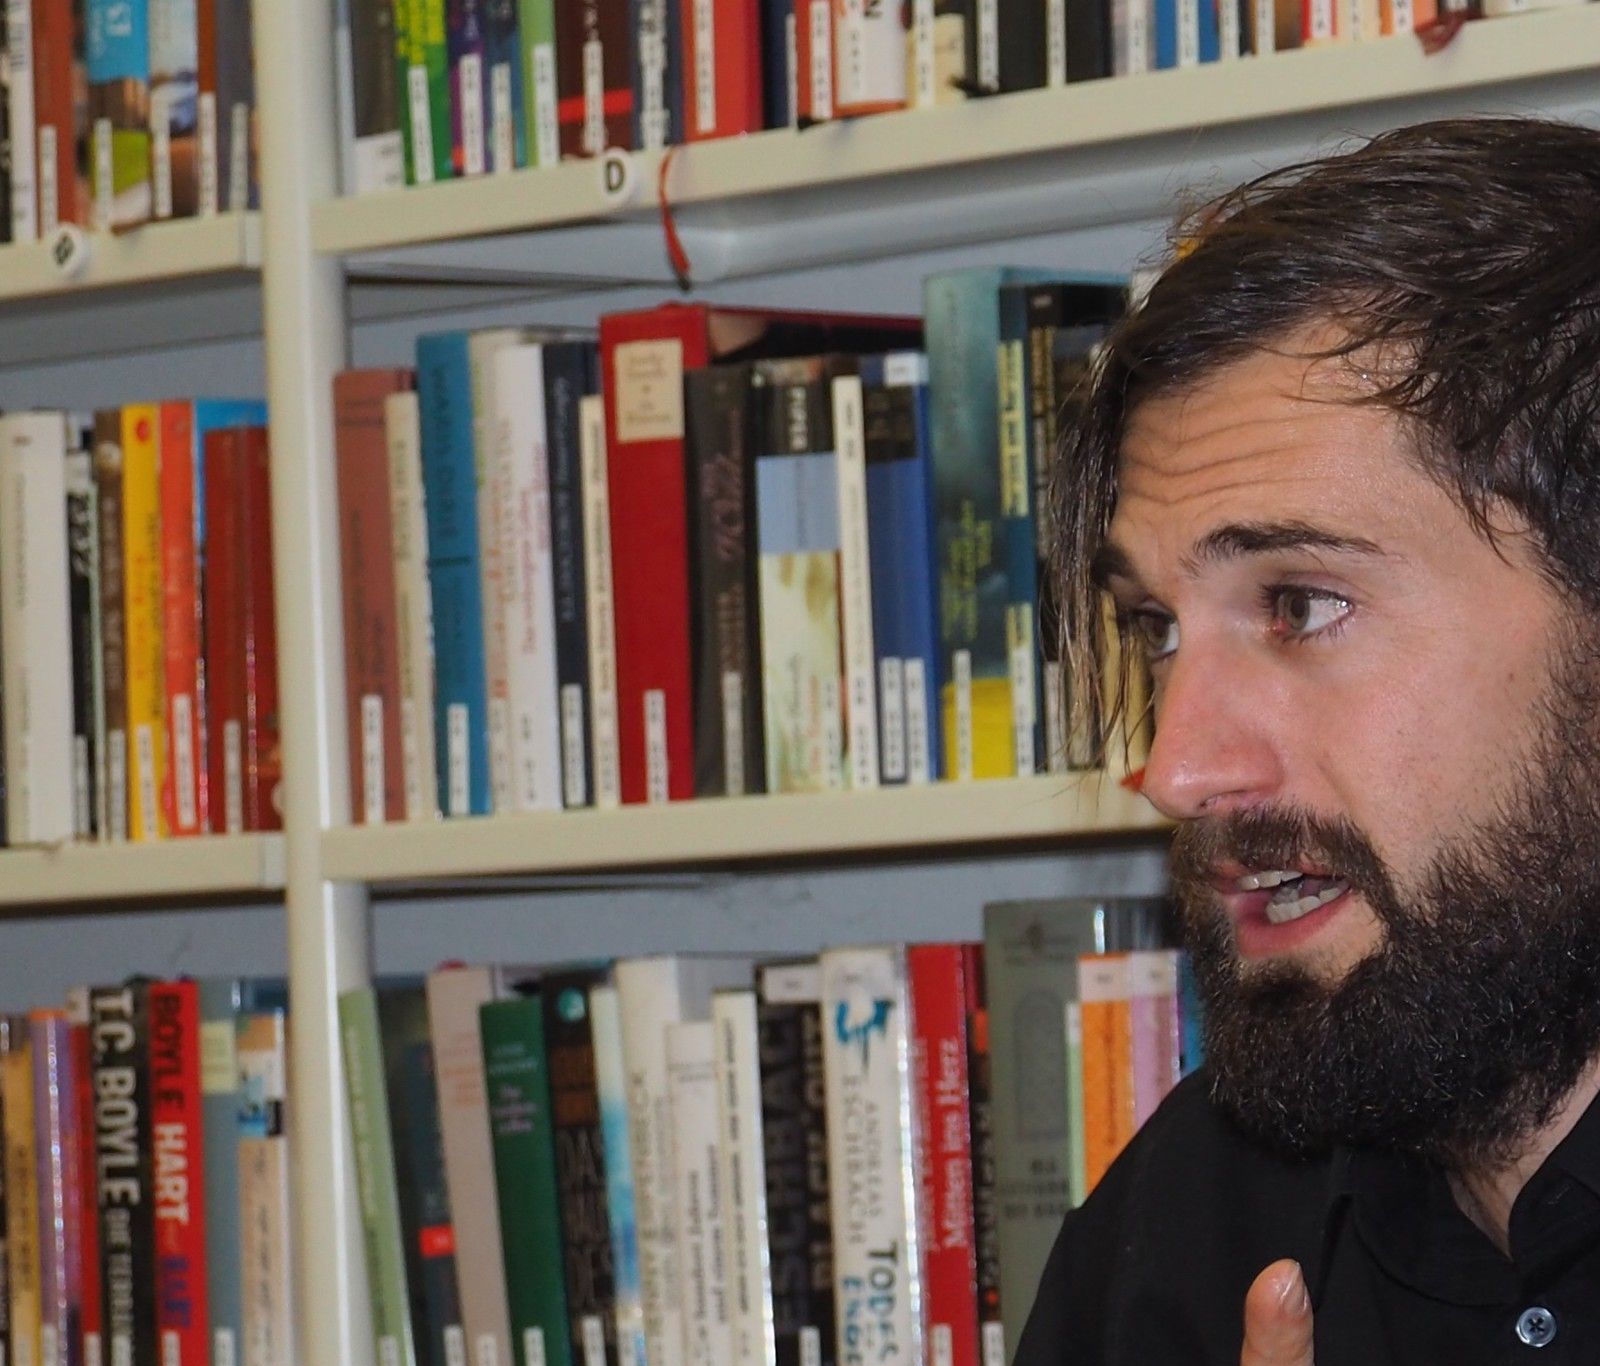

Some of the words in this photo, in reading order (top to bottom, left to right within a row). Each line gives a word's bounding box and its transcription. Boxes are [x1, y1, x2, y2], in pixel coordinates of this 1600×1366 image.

[604, 158, 626, 194] D
[94, 1065, 142, 1208] BOYLE
[155, 1123, 190, 1226] HART
[866, 1238, 898, 1363] TODES
